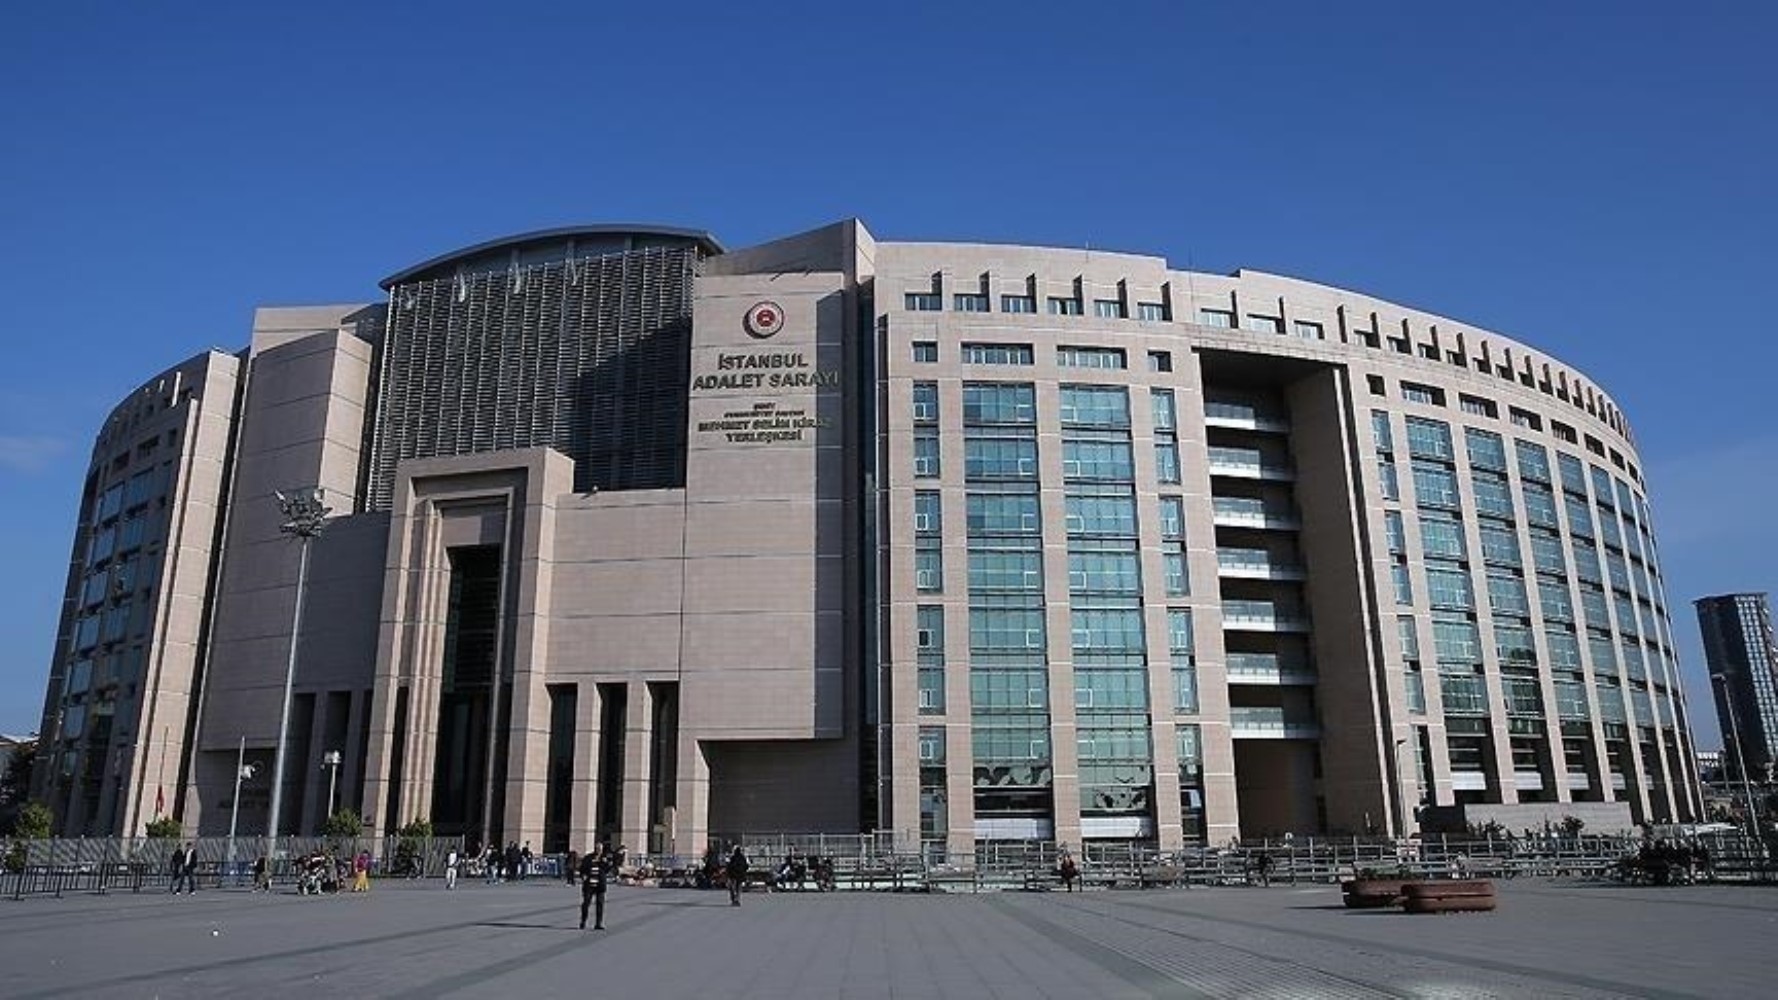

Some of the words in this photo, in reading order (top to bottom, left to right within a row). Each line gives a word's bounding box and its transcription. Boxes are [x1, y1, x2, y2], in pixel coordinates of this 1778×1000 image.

[718, 353, 809, 370] İSTANBUL
[693, 373, 765, 391] ADALET
[768, 370, 840, 388] SARAYI
